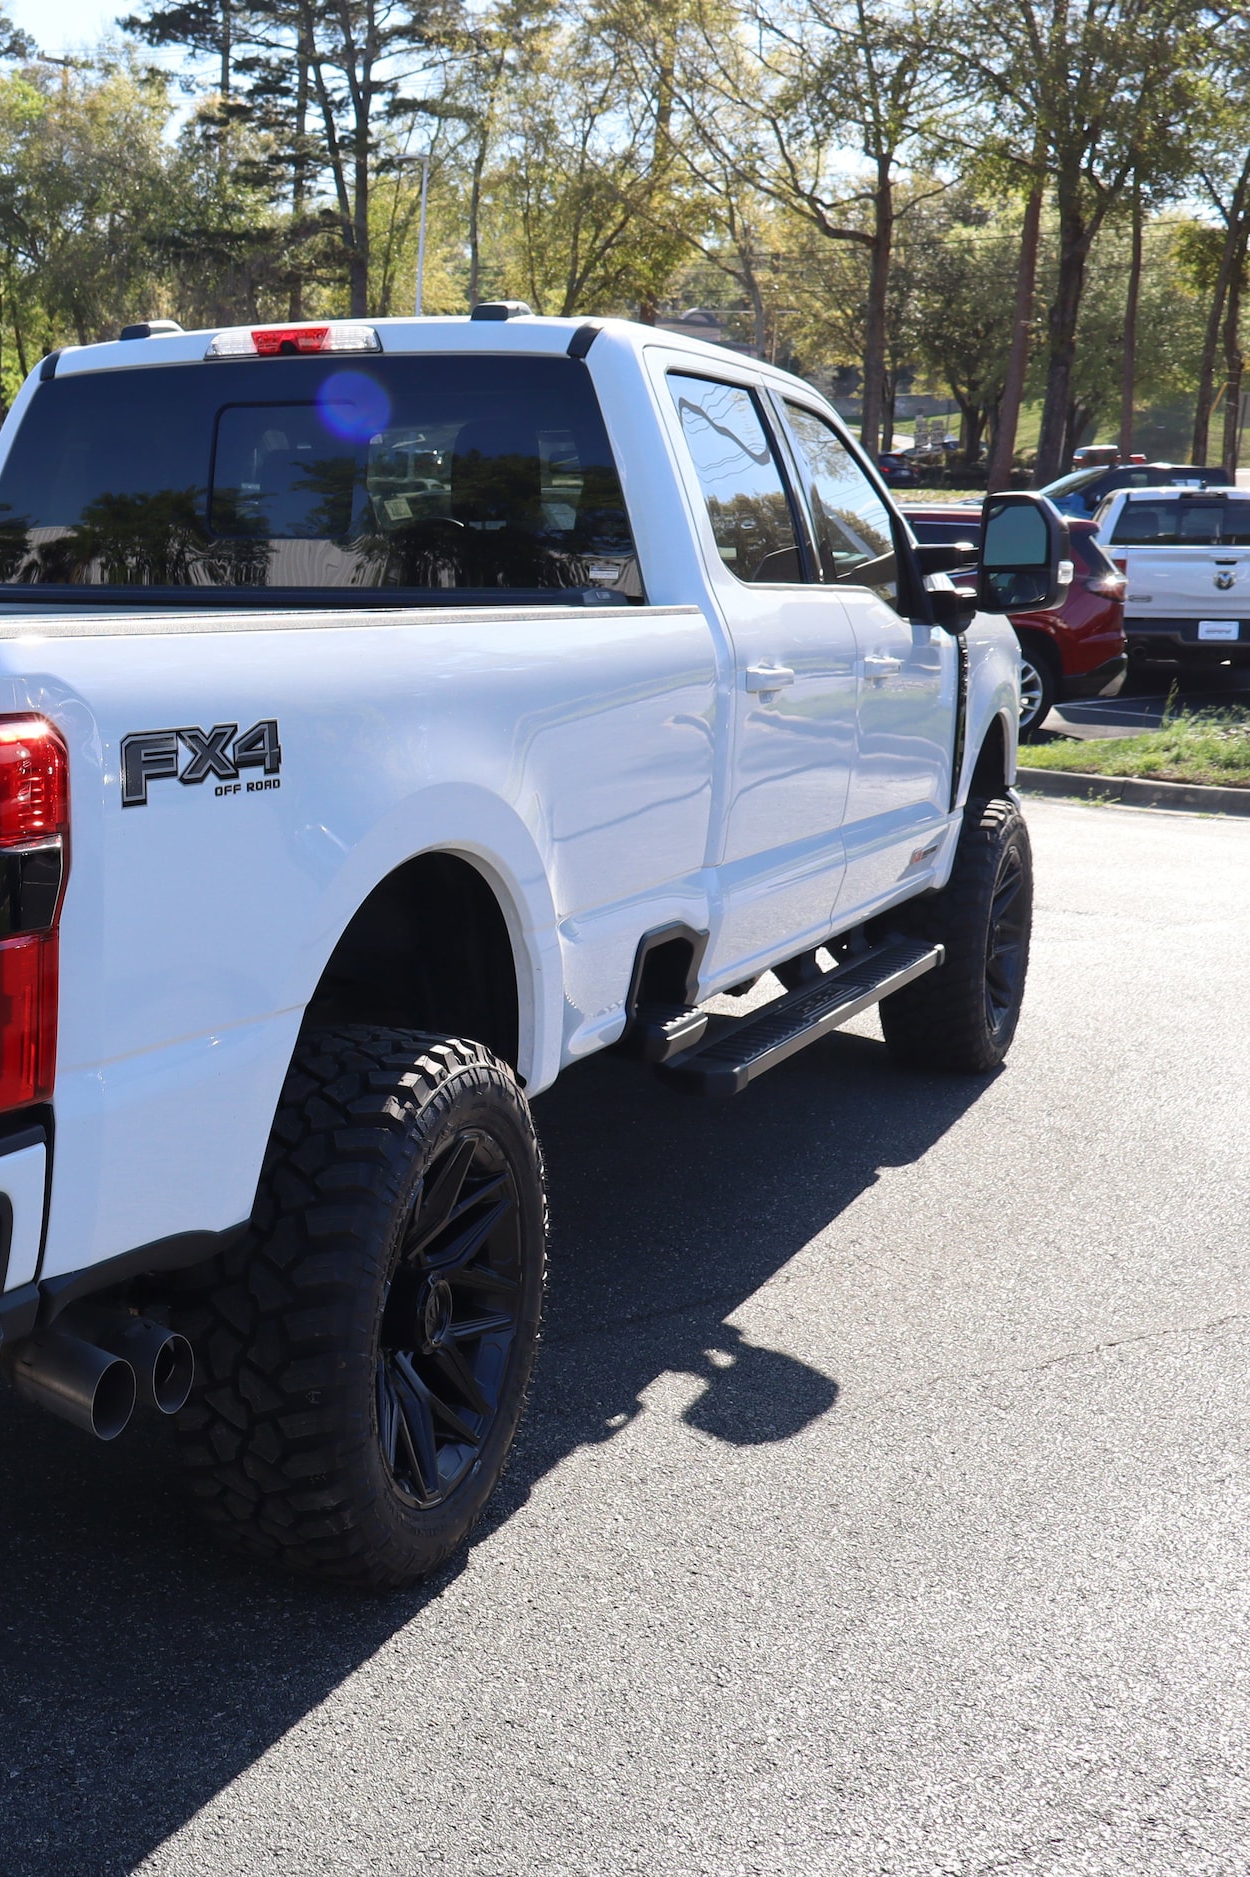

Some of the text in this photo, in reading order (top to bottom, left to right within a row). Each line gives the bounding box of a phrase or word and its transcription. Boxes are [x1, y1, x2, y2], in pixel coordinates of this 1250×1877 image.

[120, 718, 281, 808] FX4
[214, 779, 280, 796] OFF ROAD
